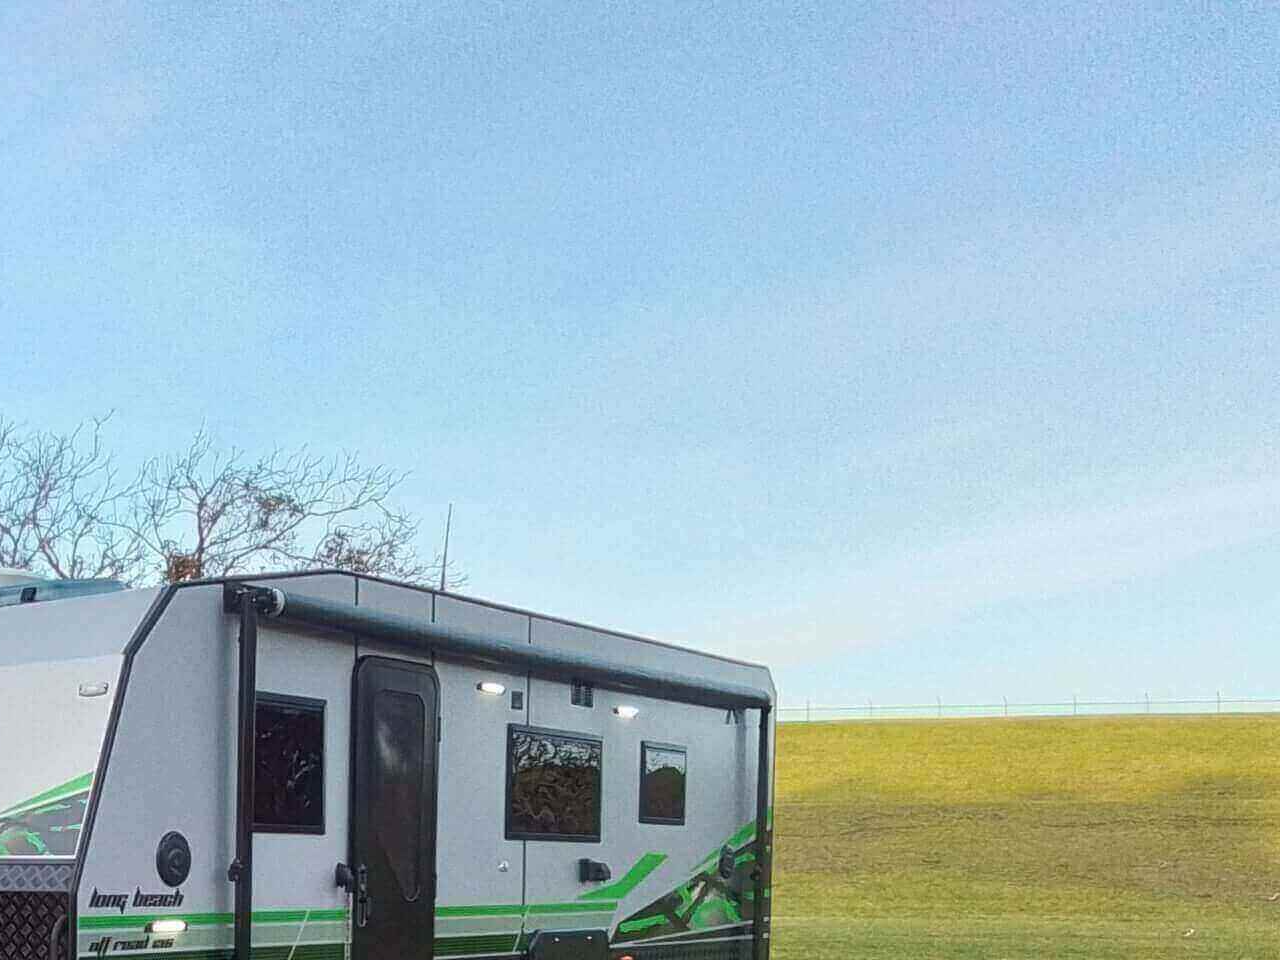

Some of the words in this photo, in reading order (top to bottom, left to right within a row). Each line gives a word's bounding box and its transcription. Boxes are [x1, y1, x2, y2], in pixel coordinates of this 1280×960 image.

[88, 886, 129, 914] long
[132, 885, 184, 907] beach
[88, 936, 112, 959] off
[112, 935, 150, 951] road
